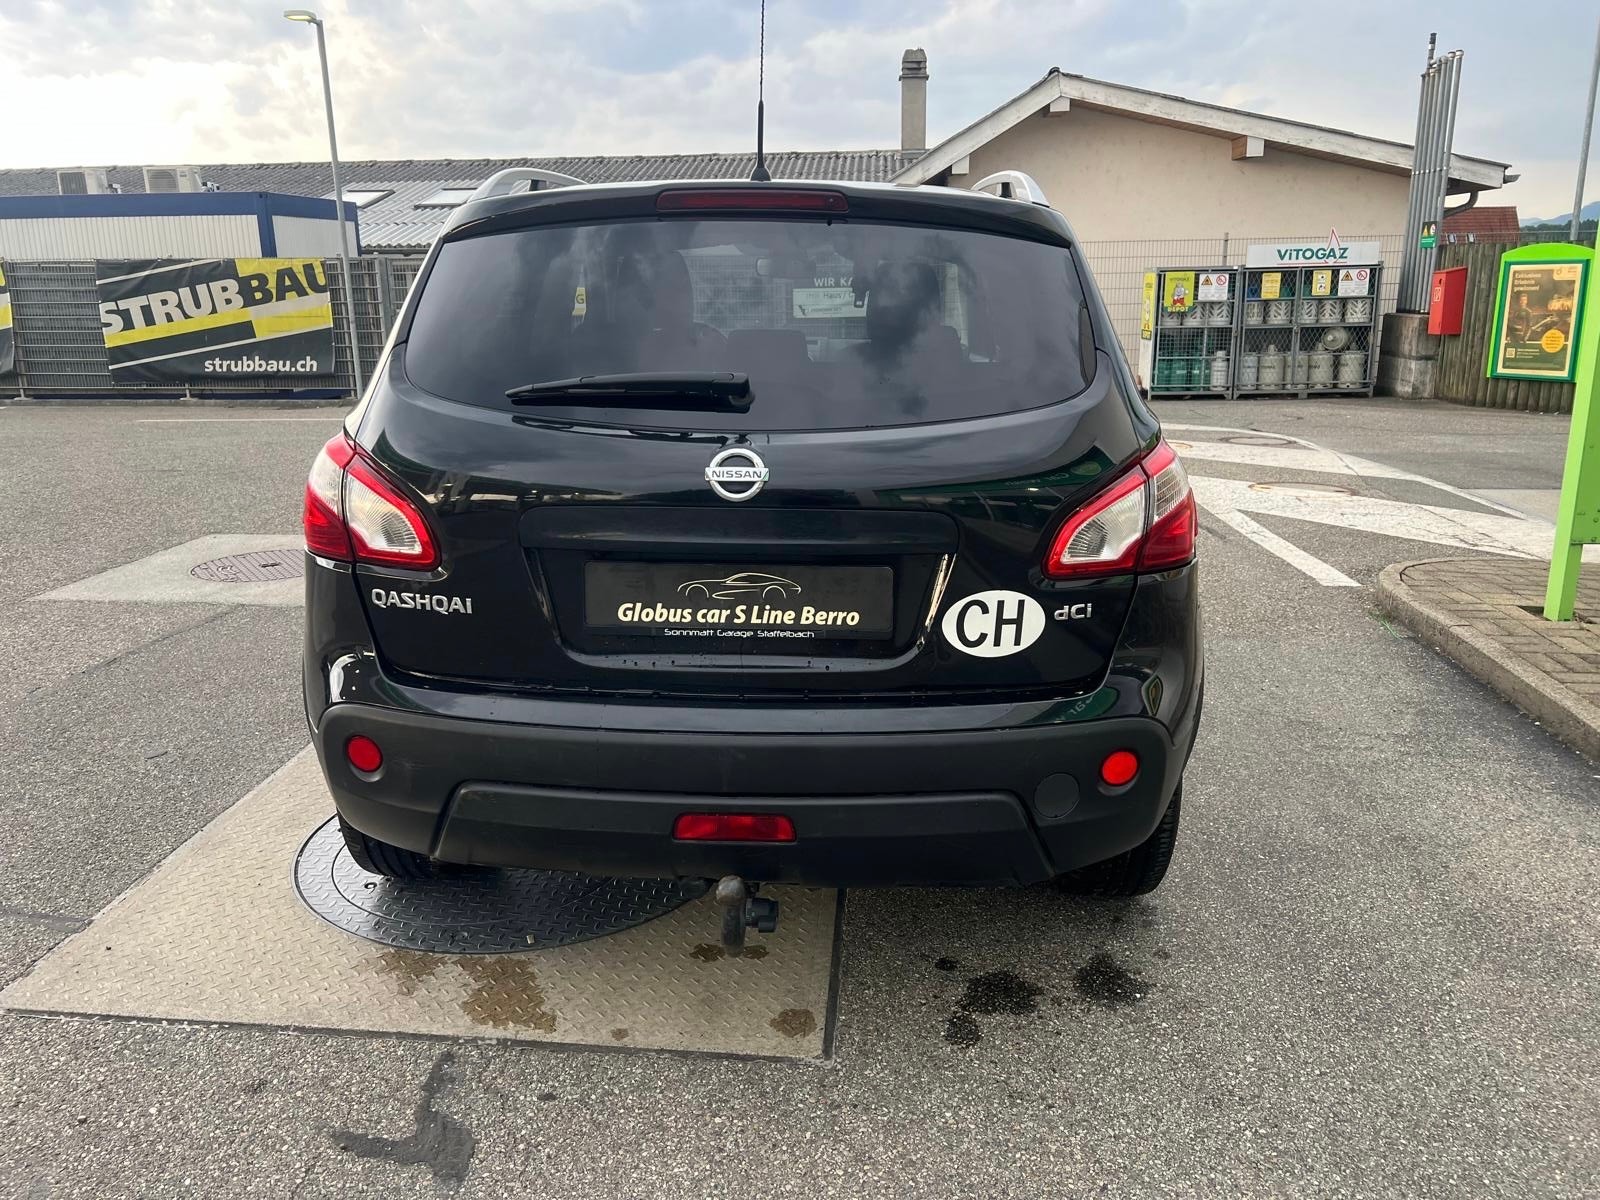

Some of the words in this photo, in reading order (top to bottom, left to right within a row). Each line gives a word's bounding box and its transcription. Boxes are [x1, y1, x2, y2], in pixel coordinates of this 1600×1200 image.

[814, 277, 835, 287] WIR
[99, 260, 329, 333] STRUBBAU
[204, 355, 318, 373] strubbau.ch
[711, 470, 762, 479] NISSAN
[371, 588, 473, 615] QASHQAI
[617, 602, 692, 623] Globus
[696, 607, 731, 624] car
[733, 604, 747, 625] S
[750, 604, 796, 625] Line
[799, 606, 860, 626] Berro
[1054, 603, 1093, 621] dCi
[956, 599, 1025, 649] CH
[664, 628, 715, 637] Sonnmatt
[716, 628, 754, 639] Garage
[756, 629, 815, 639] Staffelbach
